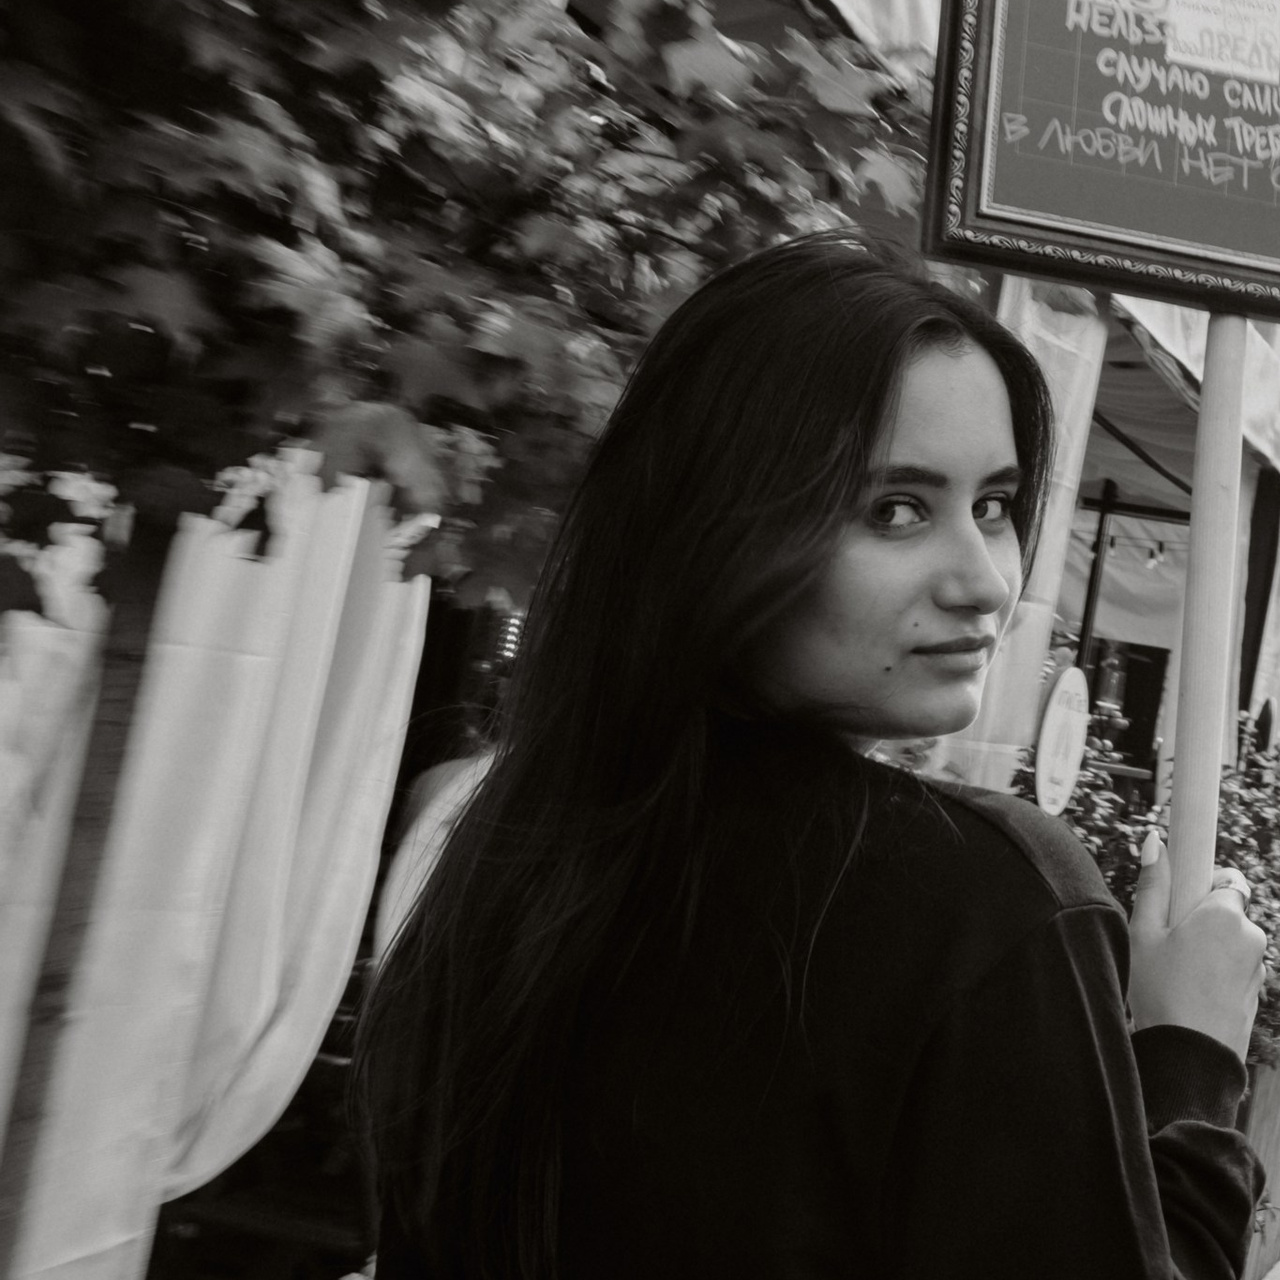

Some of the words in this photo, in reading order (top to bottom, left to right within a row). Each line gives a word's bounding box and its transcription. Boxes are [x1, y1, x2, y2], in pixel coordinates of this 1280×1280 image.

[1096, 47, 1210, 100] СЛУЧАЮ
[1002, 112, 1030, 143] В
[1038, 118, 1163, 173] ЛЮБВИ
[1181, 146, 1264, 191] НЕТ
